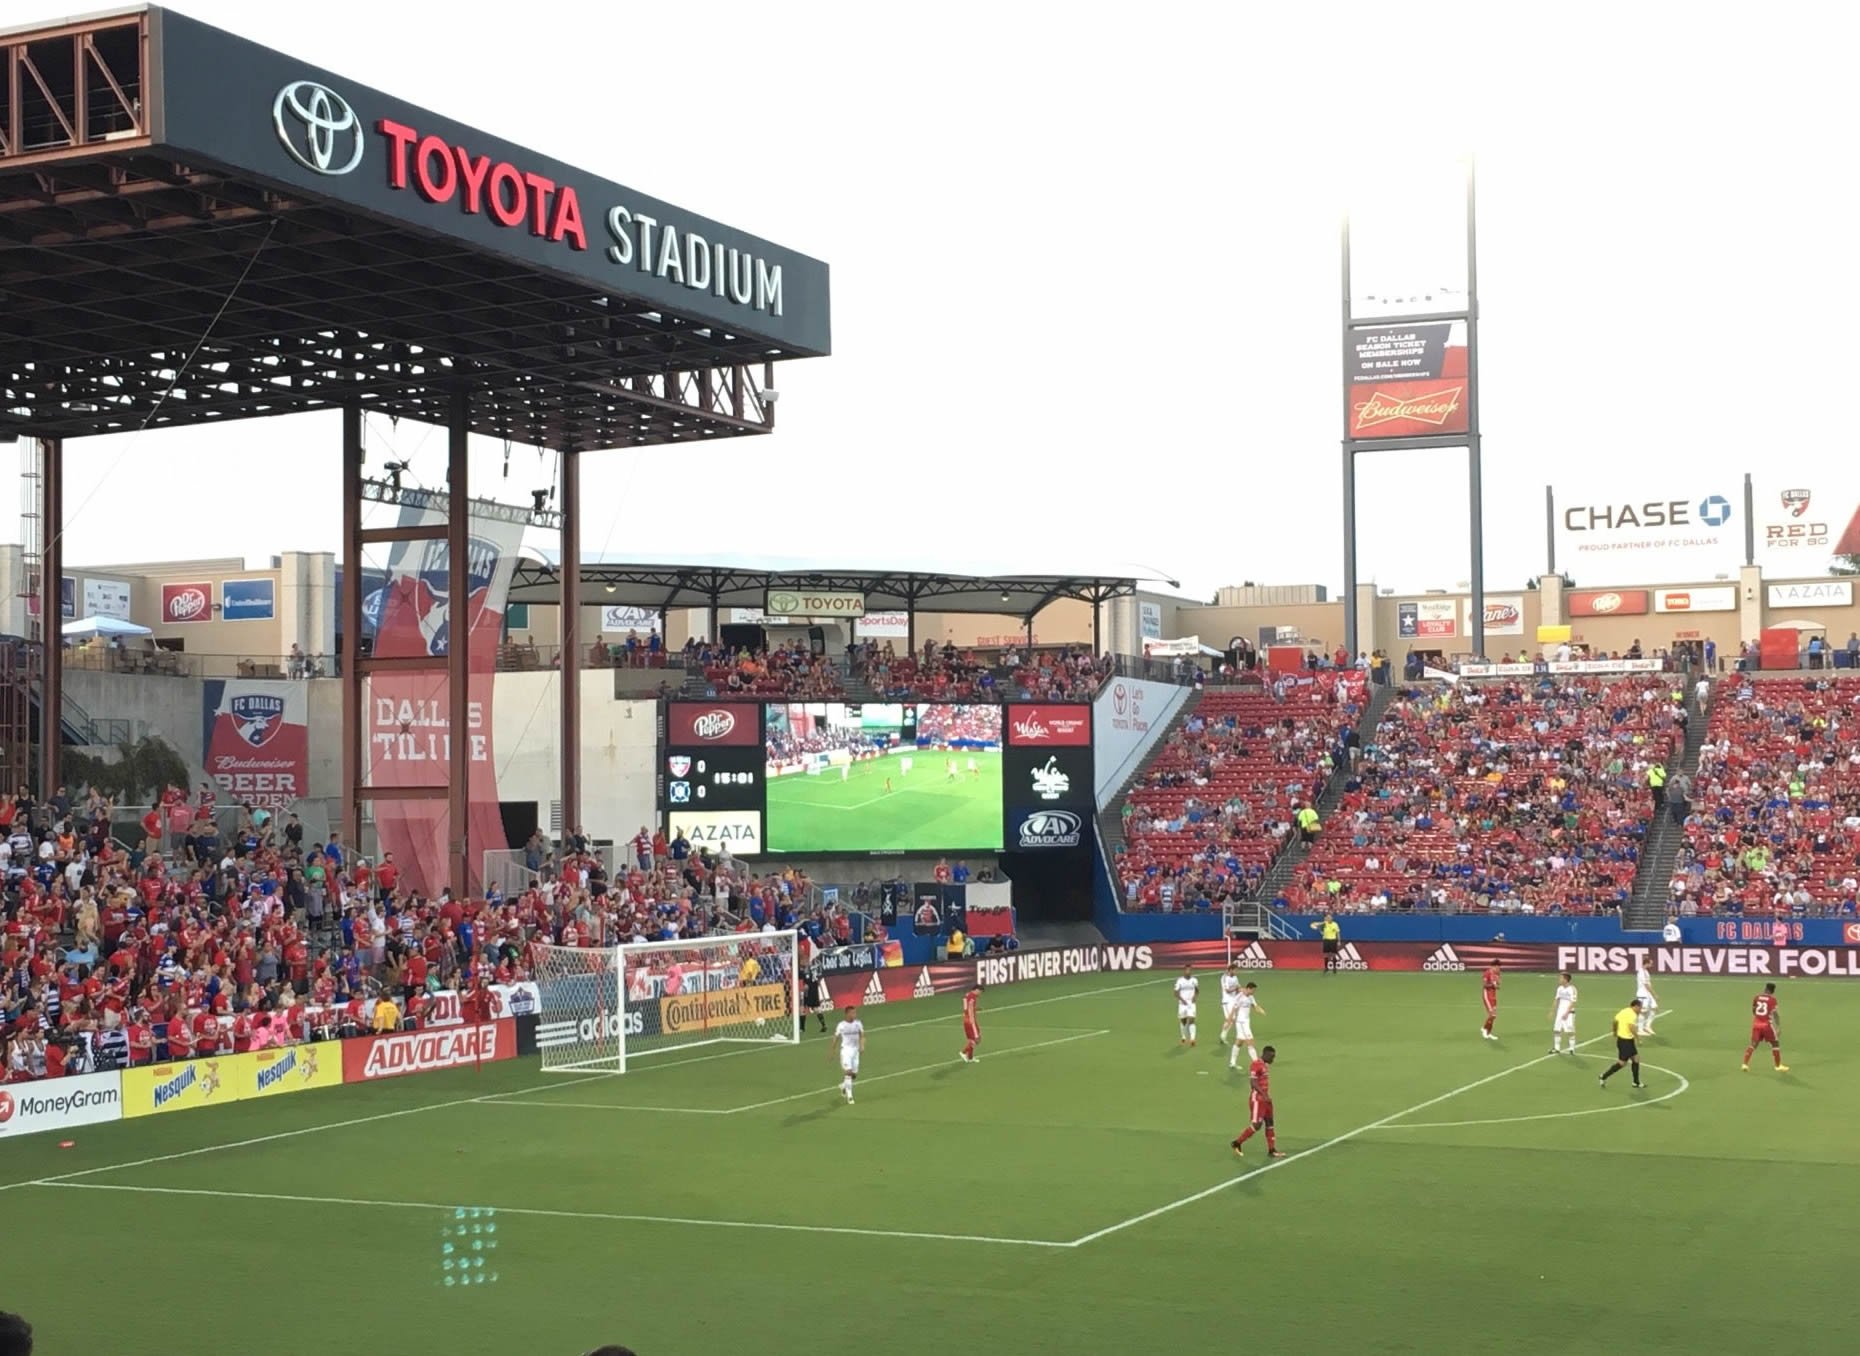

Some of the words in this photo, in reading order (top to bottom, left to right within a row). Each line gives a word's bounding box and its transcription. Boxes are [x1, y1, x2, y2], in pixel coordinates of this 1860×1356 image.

[379, 119, 588, 252] TOYOTA
[606, 205, 784, 317] STADIUM
[1393, 340, 1427, 349] TICKET
[1376, 360, 1399, 368] SALE
[1401, 358, 1422, 366] NOW
[1354, 400, 1459, 420] Budweiser
[1565, 500, 1690, 531] CHASE
[1766, 523, 1828, 539] RED
[1611, 541, 1651, 551] PARTNER
[1654, 540, 1666, 549] OF
[1668, 539, 1680, 547] FC
[1682, 537, 1719, 547] DALLAS
[1767, 538, 1800, 548] FOR
[803, 597, 864, 610] TOYOTA
[1483, 605, 1518, 621] ane's
[859, 616, 908, 627] SportsDay
[1003, 634, 1039, 646] SERVICS
[234, 699, 246, 711] FC
[248, 697, 281, 711] DALLAS
[376, 698, 482, 728] DALLS
[708, 713, 723, 724] Dr
[698, 716, 731, 737] Pepper
[214, 755, 296, 769] Budweiser
[214, 773, 296, 791] BEER
[1022, 835, 1078, 845] ADVOCARE
[1716, 922, 1737, 940] FC
[1741, 922, 1804, 941] DALAS
[1234, 958, 1273, 969] adidas
[1328, 959, 1368, 971] adidas
[1423, 960, 1465, 972] adidas
[1558, 946, 1650, 971] FIRST
[1657, 948, 1771, 974] NEVER
[976, 957, 1016, 985] FIRST
[1018, 951, 1060, 980] NEVER
[863, 993, 886, 1006] adidas
[913, 986, 935, 999] adidas
[667, 992, 741, 1031] Continental
[754, 994, 782, 1012] TIRE
[1755, 1001, 1768, 1016] 23
[579, 1010, 644, 1041] adidas
[364, 1023, 496, 1077] ADVOCARE
[257, 1050, 297, 1091] Nesquik
[154, 1064, 197, 1107] Nesquik
[20, 1089, 118, 1117] MoneyGram
